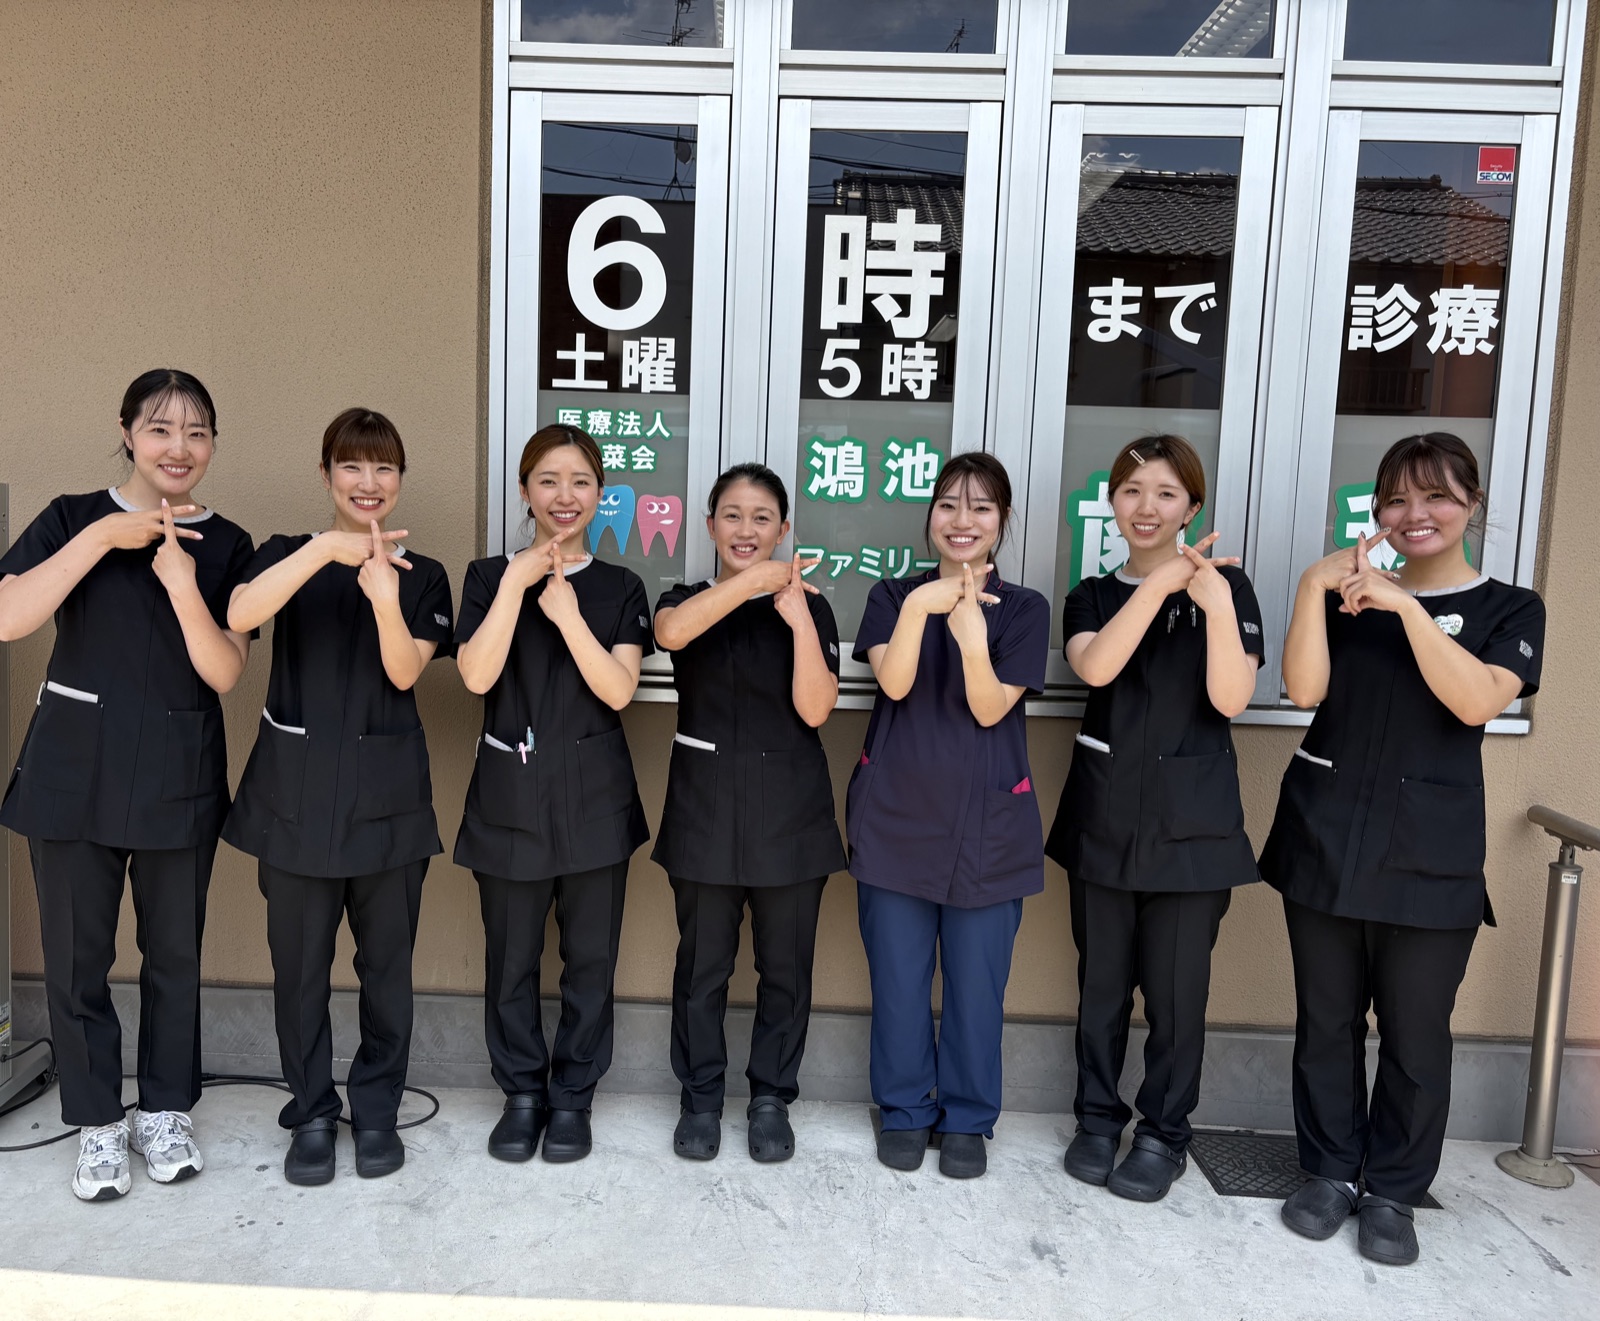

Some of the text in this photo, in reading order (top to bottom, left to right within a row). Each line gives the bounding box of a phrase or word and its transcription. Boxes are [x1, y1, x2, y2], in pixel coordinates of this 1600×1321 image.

[1479, 172, 1512, 182] SECOM
[567, 195, 1501, 356] 6 時 まで 診療
[552, 333, 938, 399] 土曜 5時
[602, 444, 655, 470] 菜会
[808, 441, 939, 498] 鴻池
